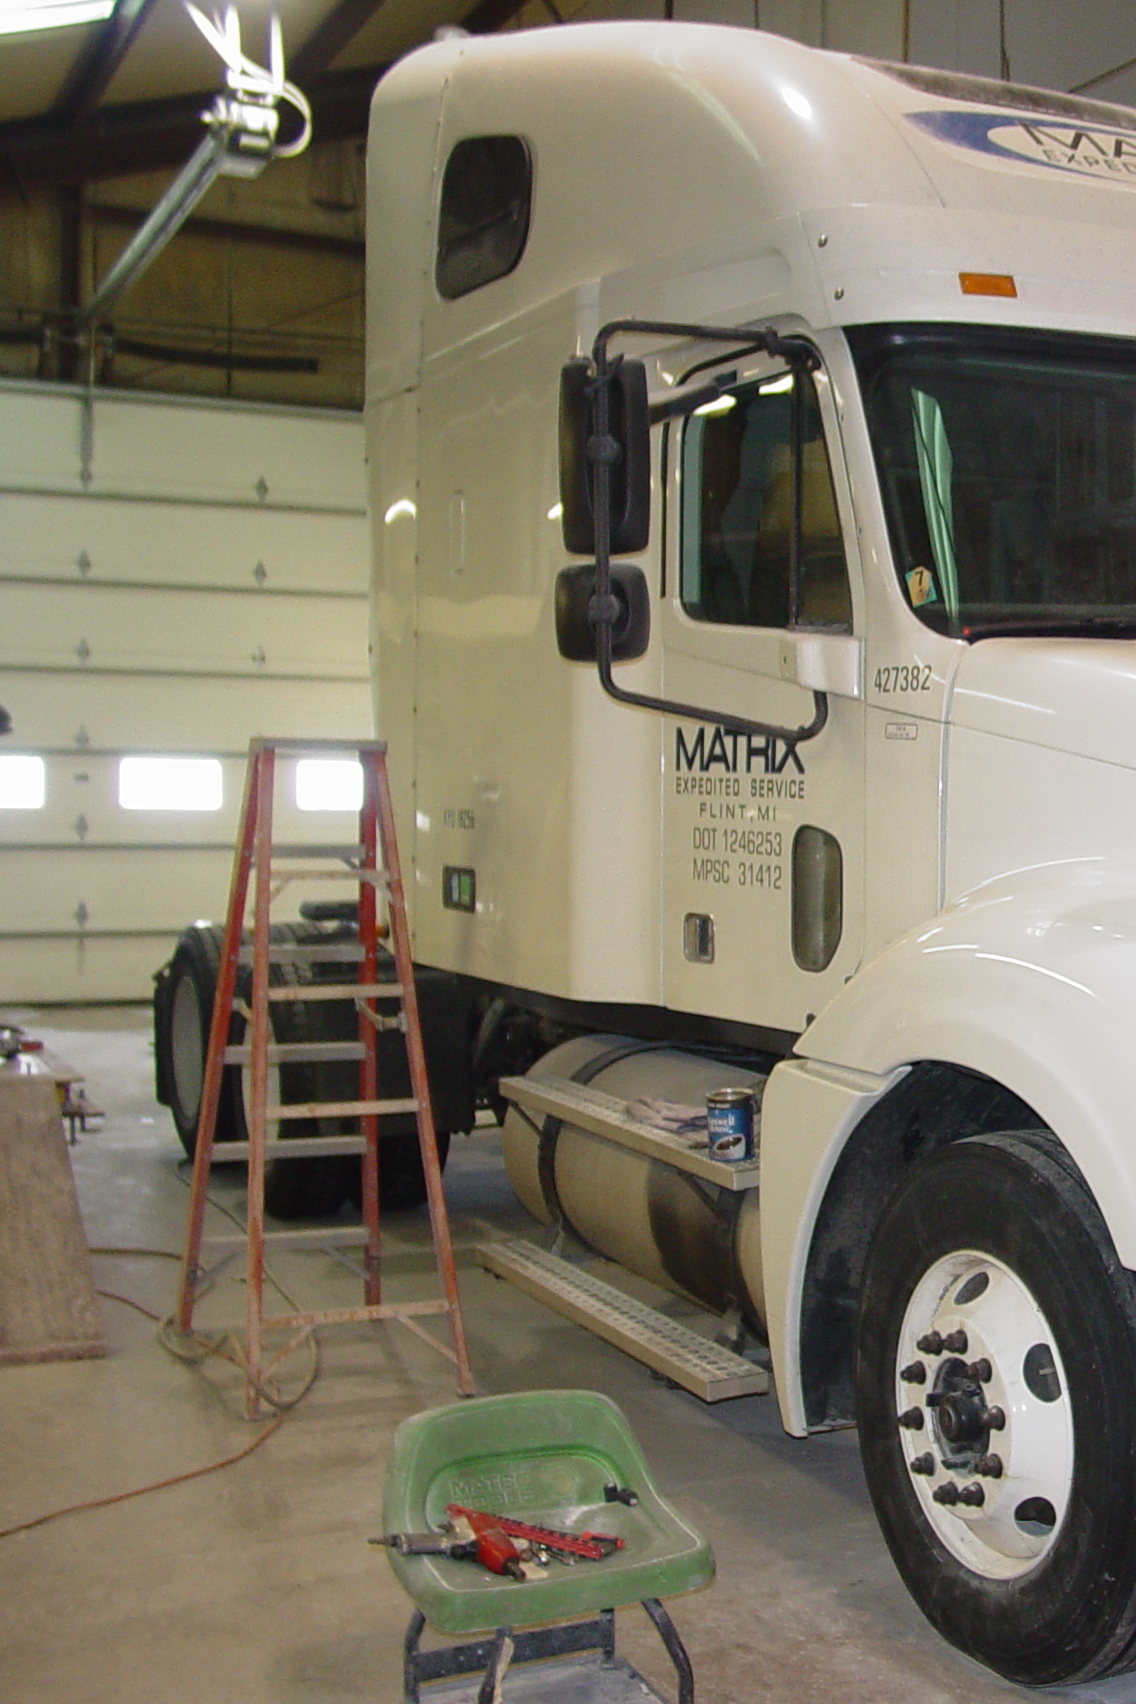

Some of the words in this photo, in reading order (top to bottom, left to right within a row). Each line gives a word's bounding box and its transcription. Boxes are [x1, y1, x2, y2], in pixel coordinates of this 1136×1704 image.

[914, 569, 924, 587] 7
[874, 664, 932, 693] 427382
[675, 726, 805, 774] MATRIX
[675, 777, 740, 797] EXPEDITED
[750, 778, 805, 799] SERVICE
[693, 827, 717, 850] DOT
[722, 829, 782, 856] 1246253
[693, 857, 730, 884] MPSC
[738, 862, 782, 889] 31412
